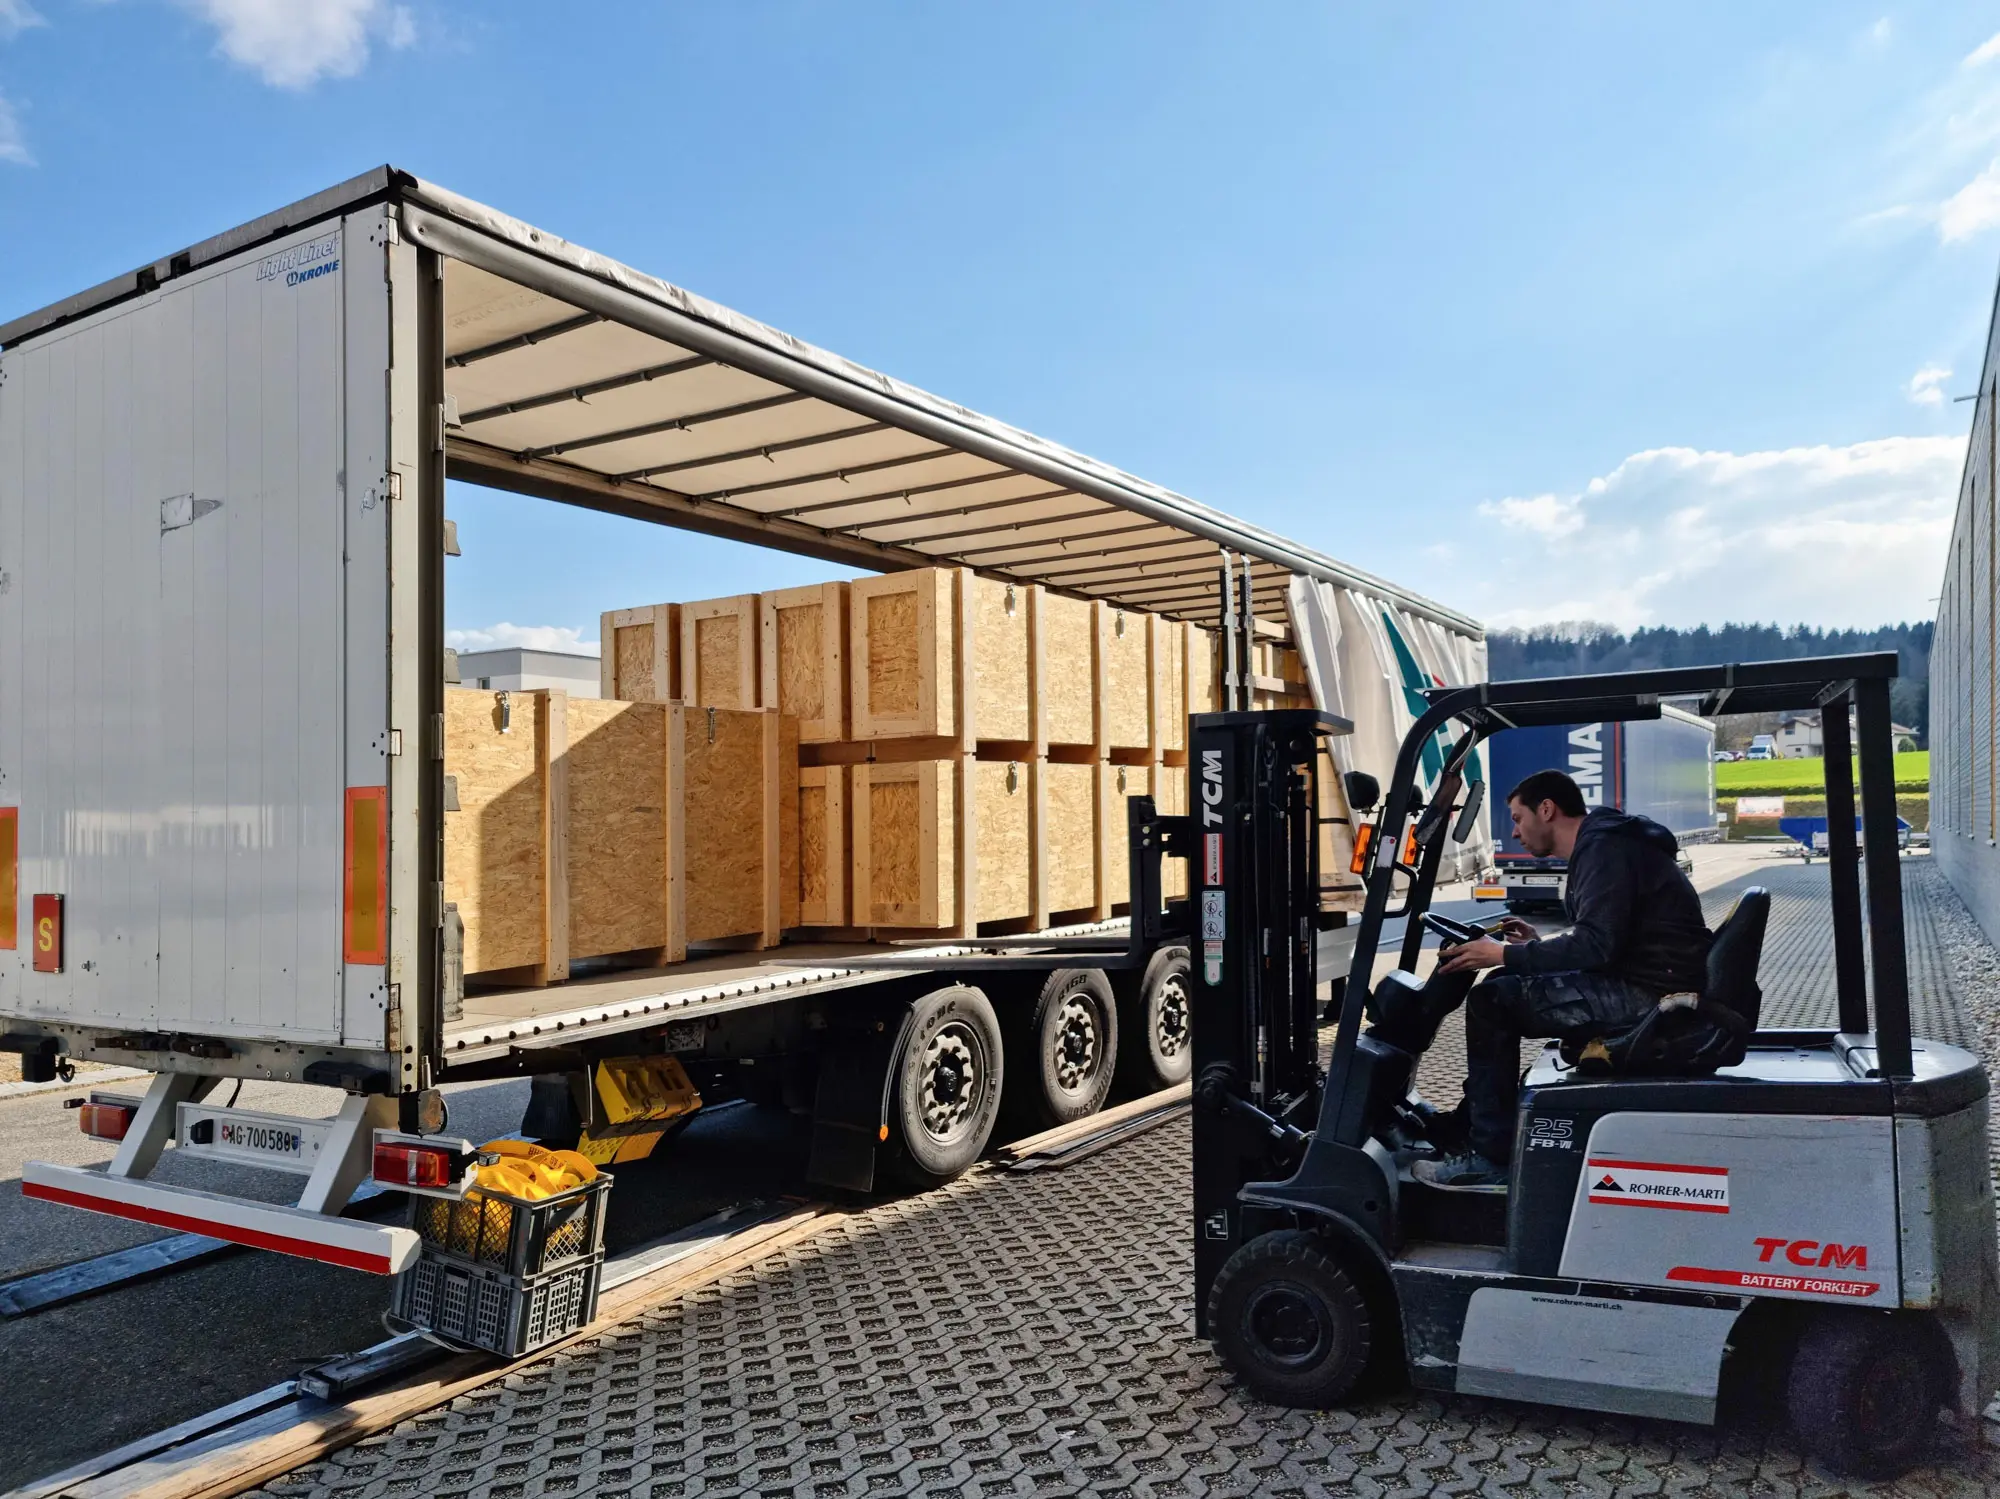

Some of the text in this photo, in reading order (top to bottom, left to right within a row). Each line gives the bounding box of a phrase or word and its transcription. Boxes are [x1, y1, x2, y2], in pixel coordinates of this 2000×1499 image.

[256, 237, 340, 281] Light Liner
[299, 259, 340, 284] KRONE
[1201, 749, 1223, 828] TCM
[39, 917, 53, 952] S
[1530, 1117, 1574, 1139] 25
[1629, 1183, 1725, 1200] ROHRER-MARTI
[1753, 1237, 1868, 1271] TCM
[1741, 1274, 1870, 1295] BATTERY FORKLIFT
[1531, 1296, 1623, 1311] www.rohrer-marti.ch
